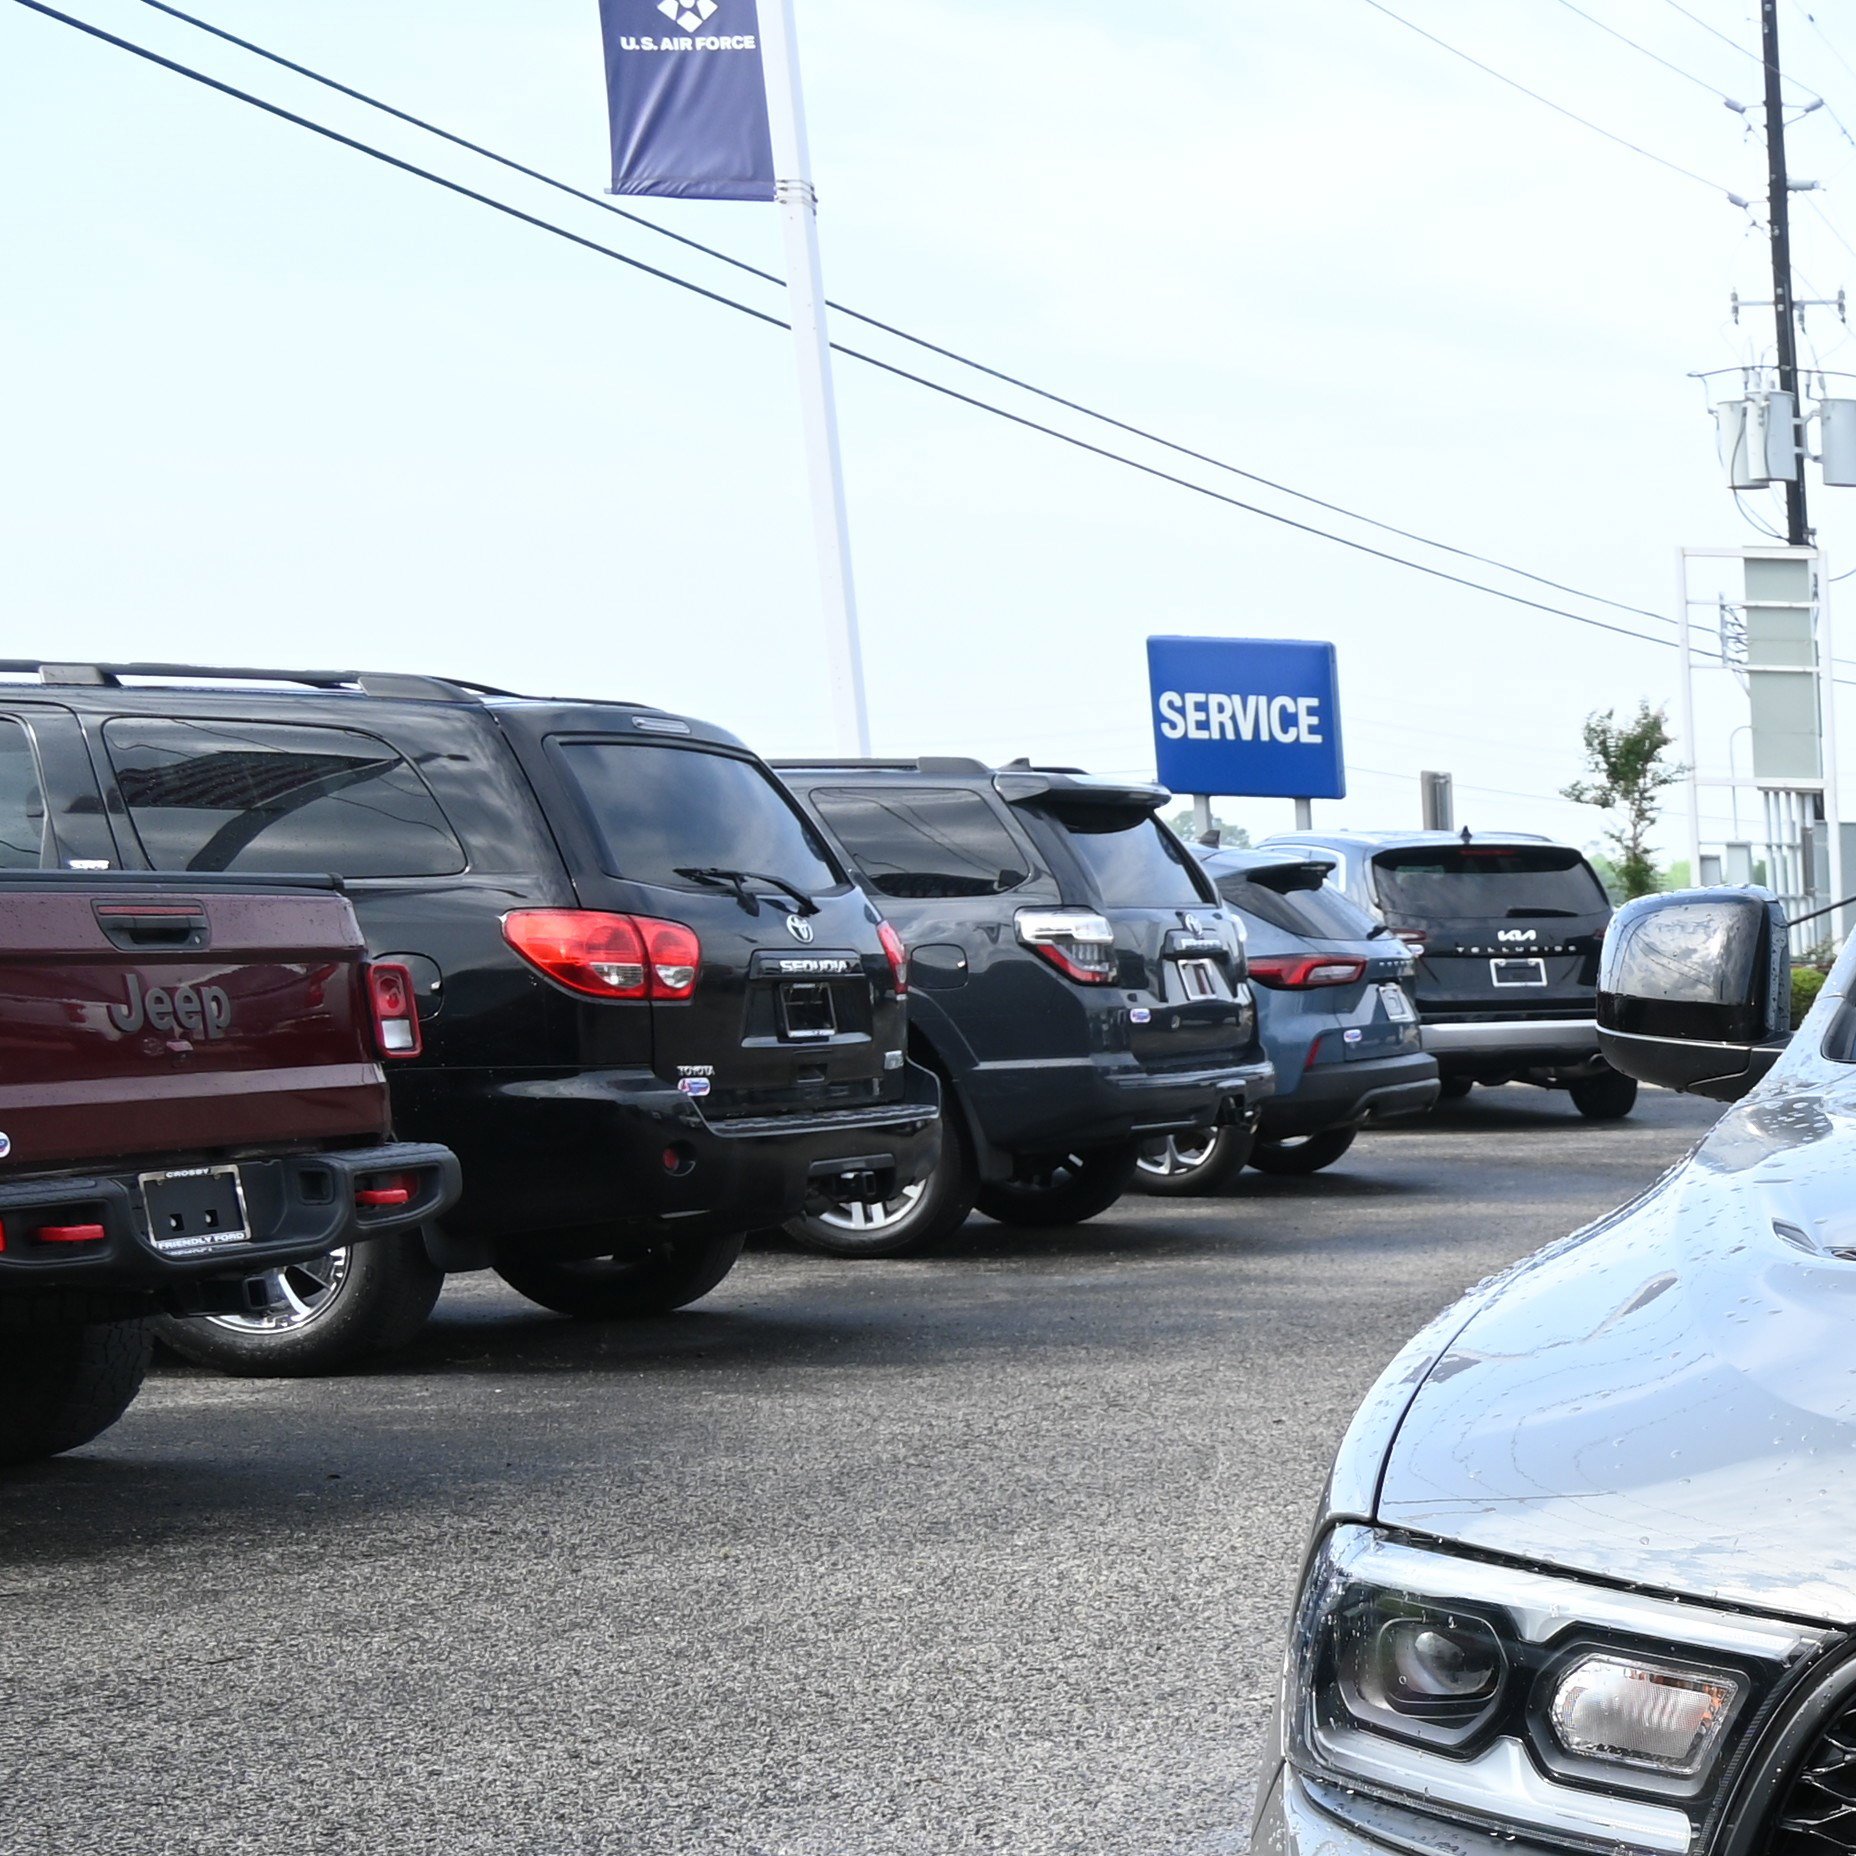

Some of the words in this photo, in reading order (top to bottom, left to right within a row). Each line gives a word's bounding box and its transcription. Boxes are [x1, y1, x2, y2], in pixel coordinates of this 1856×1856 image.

[620, 36, 658, 51] U.S.
[661, 36, 693, 51] AIR
[696, 35, 756, 50] FORCE
[1158, 690, 1323, 744] SERVICE
[779, 959, 848, 974] SEQUOIA
[108, 973, 231, 1039] Jeep
[677, 1065, 716, 1076] TOYOTA
[165, 1167, 210, 1178] CROSBY
[158, 1235, 212, 1249] FRIENDLY
[214, 1232, 245, 1242] FORD
